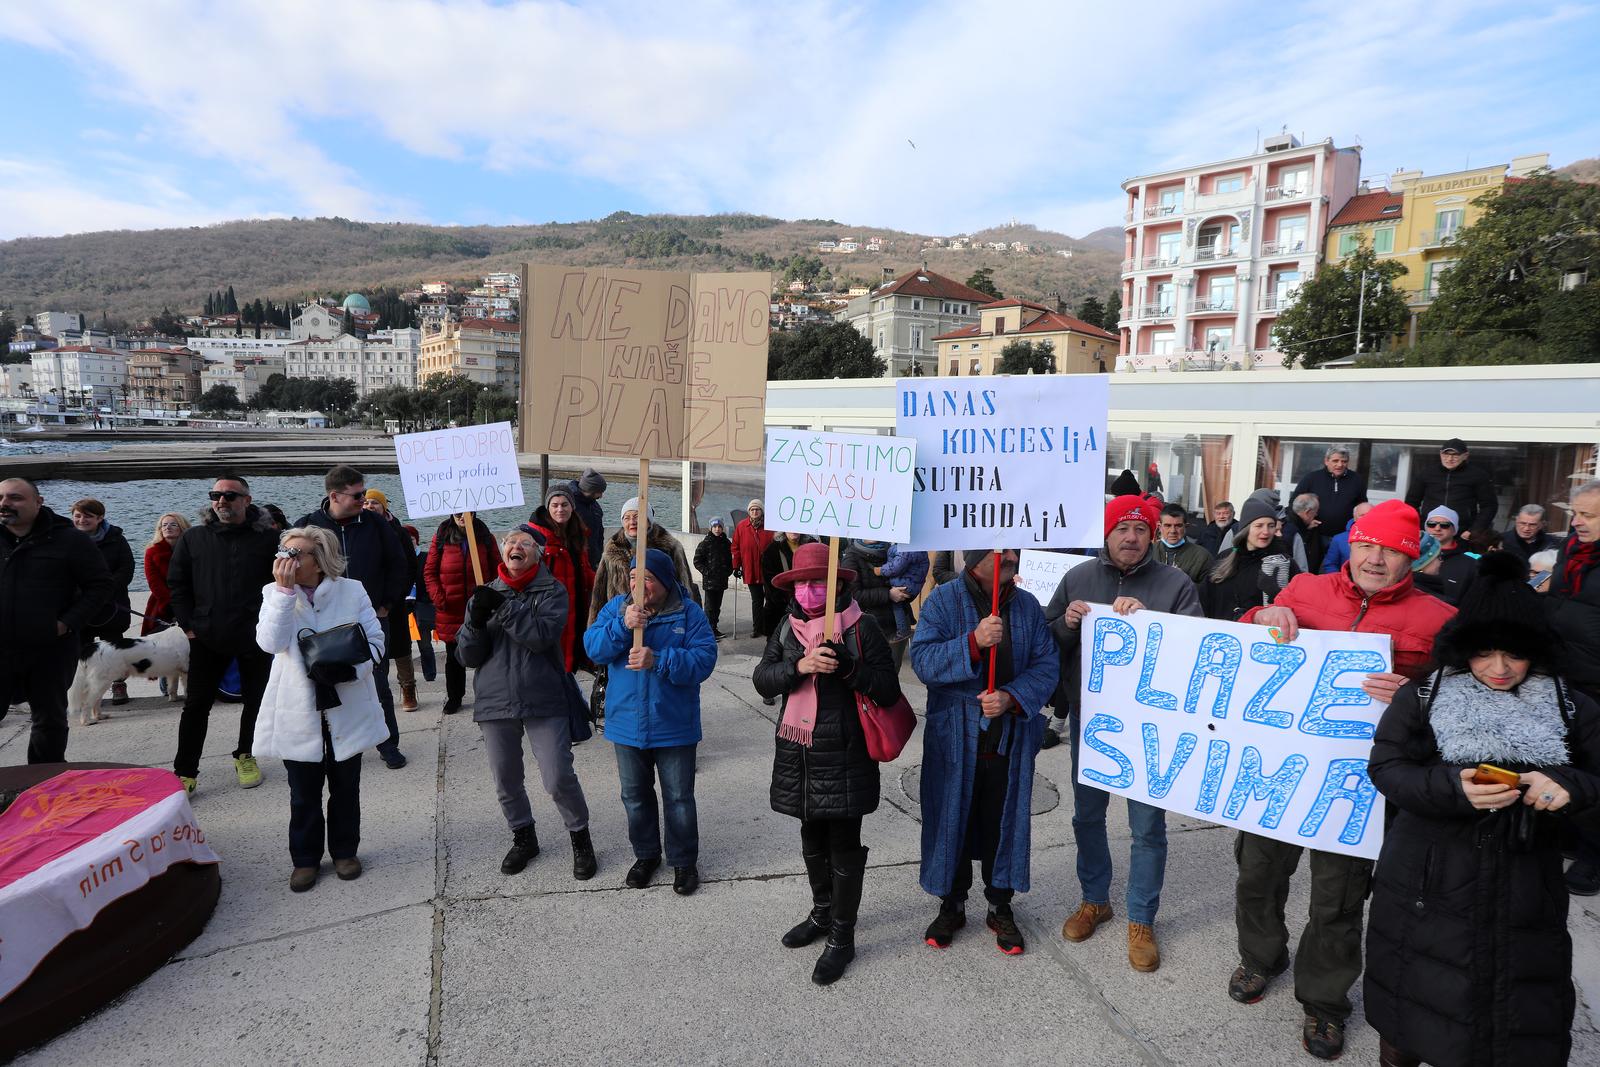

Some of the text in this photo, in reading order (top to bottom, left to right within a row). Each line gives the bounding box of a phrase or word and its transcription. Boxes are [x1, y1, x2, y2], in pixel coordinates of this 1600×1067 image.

[1420, 181, 1441, 193] VILA
[551, 272, 770, 346] NE DAMO
[609, 343, 711, 386] NAŠE
[549, 375, 763, 461] PLAŽE
[903, 390, 996, 417] DANAS
[452, 430, 511, 459] DOBRO
[770, 436, 912, 473] ZAŠTITIMO
[416, 466, 453, 485] ispred
[805, 472, 875, 501] NAŠU
[913, 466, 1002, 492] SUTRA
[779, 496, 898, 532] OBALU!
[1082, 713, 1378, 846] SVIMA
